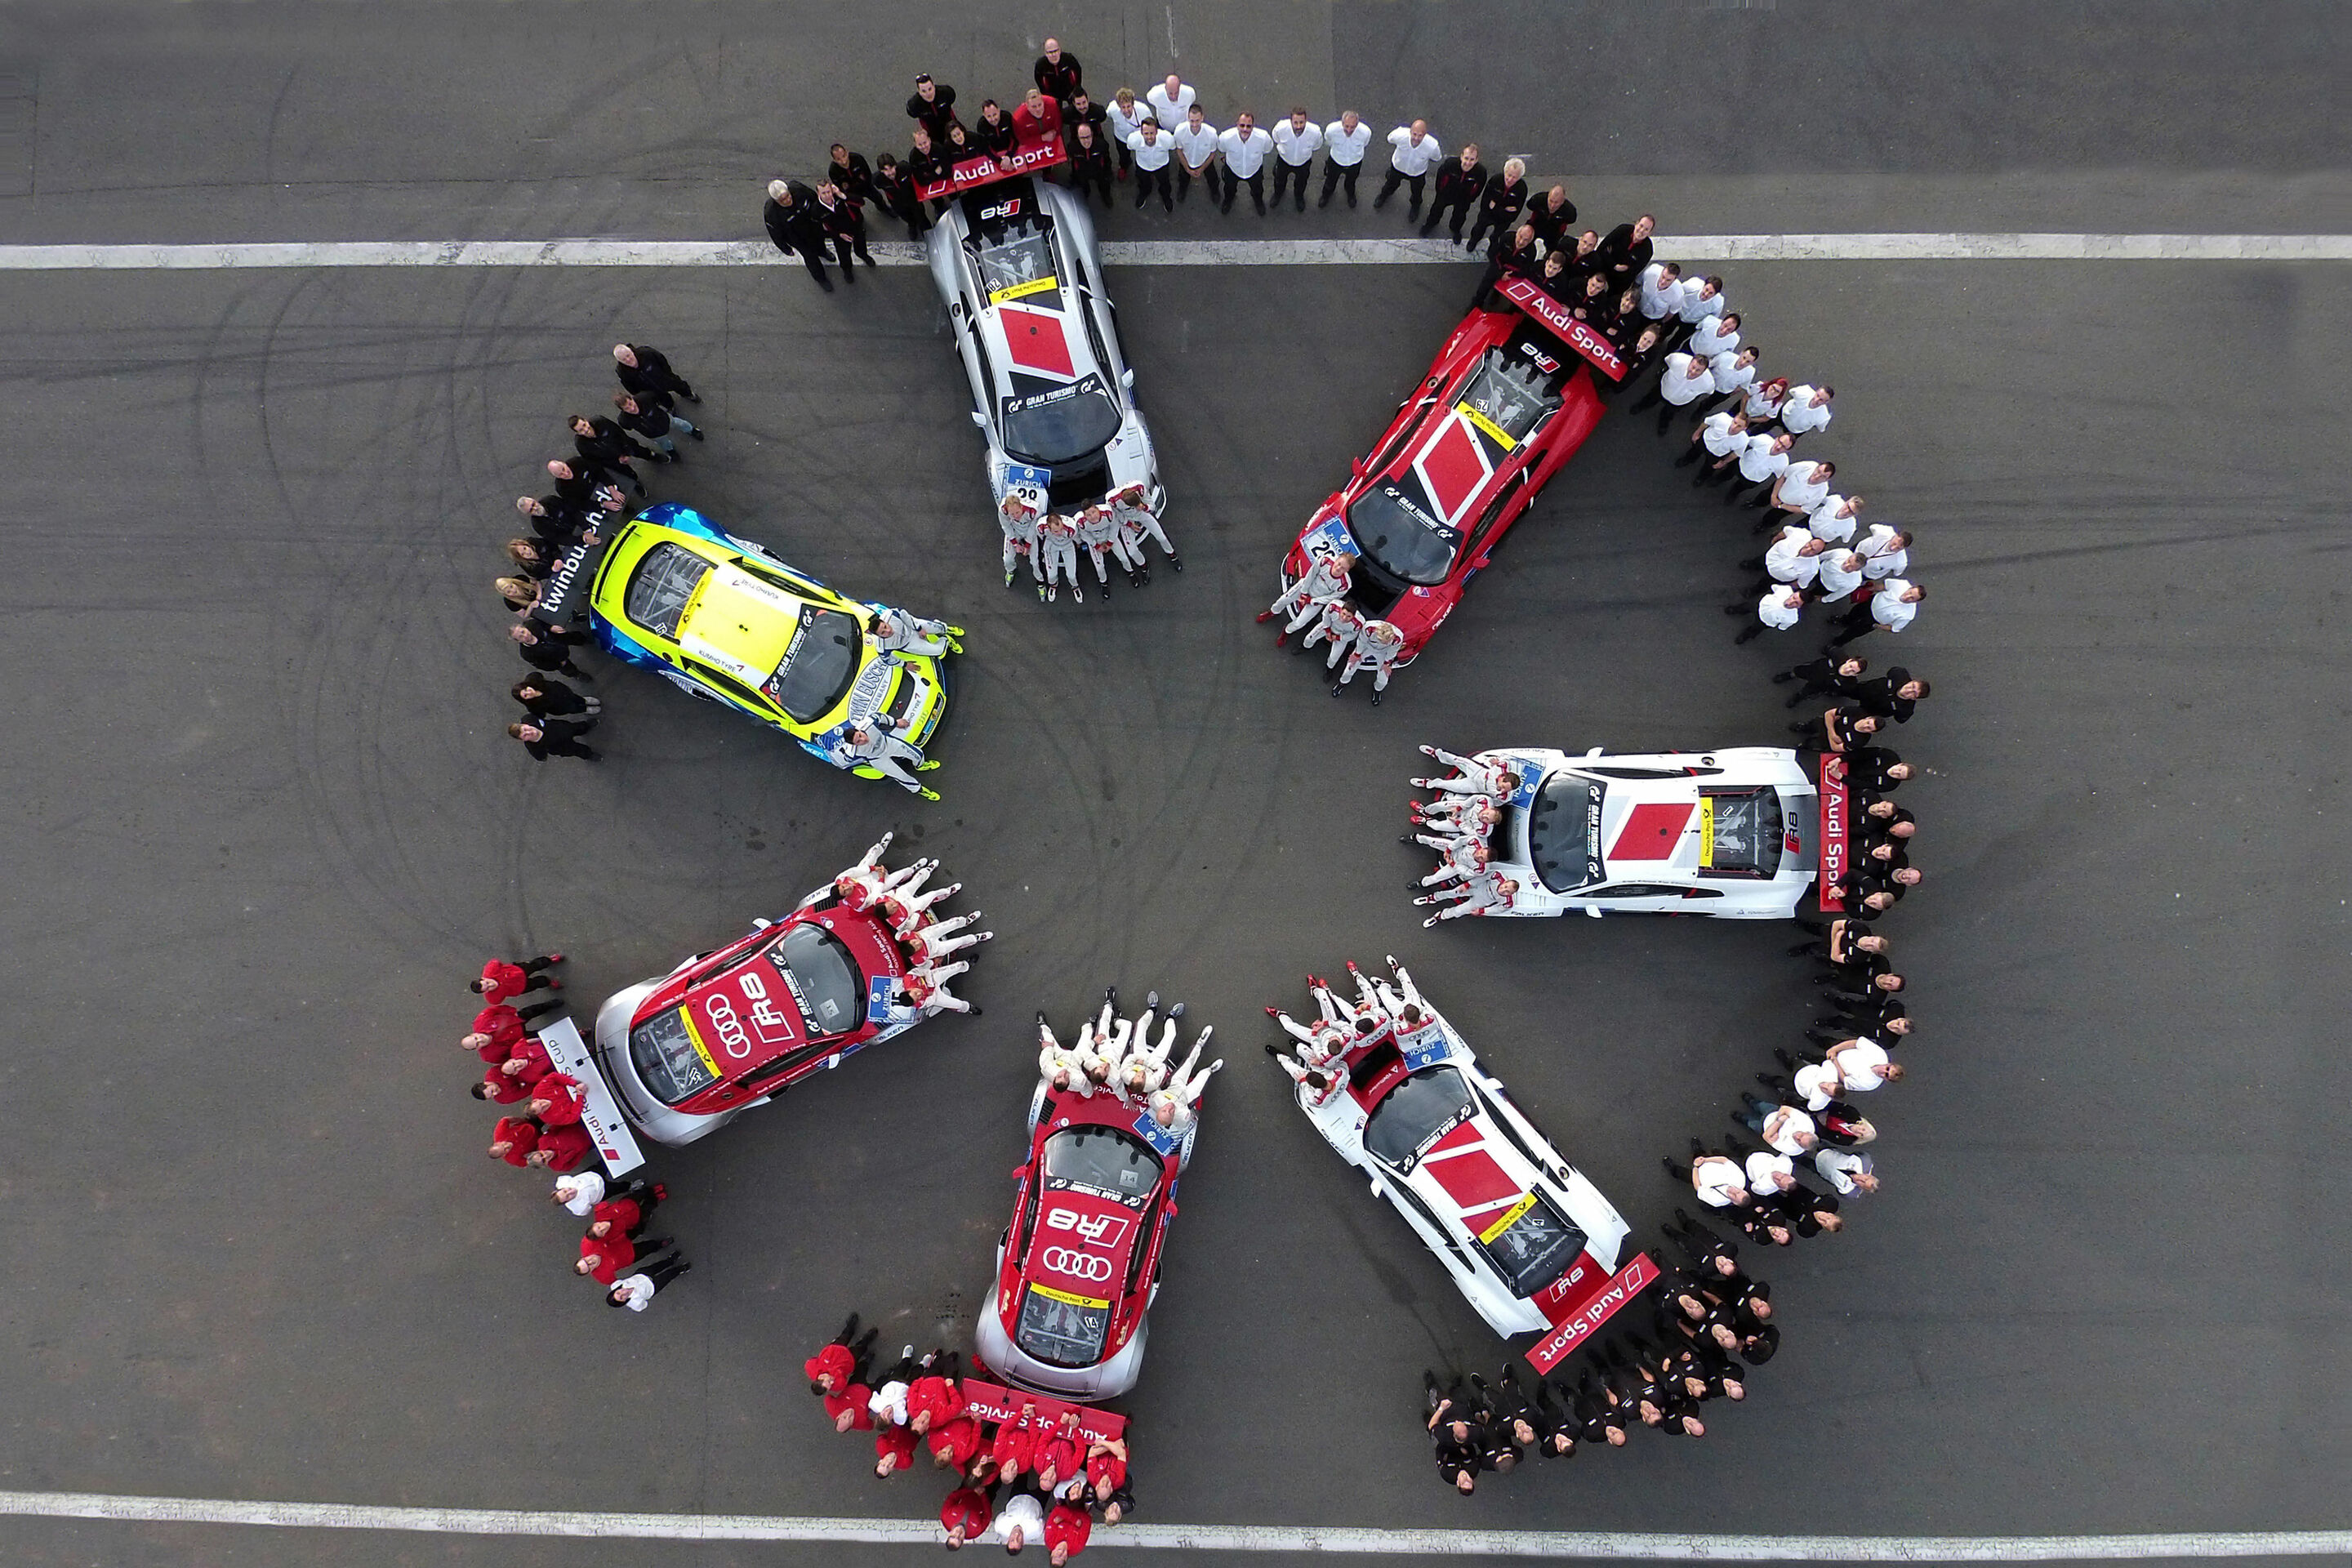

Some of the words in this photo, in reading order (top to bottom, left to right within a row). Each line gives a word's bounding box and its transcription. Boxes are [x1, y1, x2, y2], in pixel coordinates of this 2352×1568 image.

[953, 163, 996, 183] Audi
[1012, 145, 1054, 170] port
[989, 278, 1001, 292] 28
[1531, 297, 1574, 331] Audi
[1570, 325, 1620, 369] Sport
[1027, 394, 1045, 407] GRAN
[1046, 385, 1076, 402] TURISMO
[1015, 478, 1041, 488] ZURICH
[1399, 497, 1416, 513] GRAN
[1413, 507, 1439, 528] TURISMO
[1327, 532, 1343, 555] ZURIC
[698, 650, 721, 665] KUMHO
[777, 657, 792, 677] GRAN
[786, 628, 804, 659] TURISMO
[858, 660, 887, 696] BUSCH
[849, 693, 869, 721] TWIN
[871, 679, 889, 710] GERMANY
[797, 740, 824, 757] FALKEN
[1590, 804, 1598, 826] GRAN
[1828, 794, 1842, 838] Audi
[1828, 844, 1842, 899] Spor
[806, 887, 831, 902] ALKEN
[872, 933, 886, 954] Sport
[882, 952, 894, 970] Audi
[739, 972, 782, 1026] R8
[782, 969, 800, 998] TURISMO
[794, 995, 810, 1016] GRAN
[685, 1021, 699, 1045] Deutsche
[546, 1037, 567, 1065] Cup
[1410, 1042, 1436, 1057] ZURICH
[586, 1115, 610, 1147] Audi
[1147, 1118, 1169, 1140] ZURICH
[1438, 1118, 1458, 1138] GRAN
[1417, 1132, 1441, 1158] TURISMO
[1069, 1183, 1101, 1196] TURISMO
[1100, 1190, 1122, 1202] GRAN
[1046, 1208, 1107, 1238] R8
[1557, 1267, 1584, 1295] R8
[1045, 1290, 1069, 1301] Deutsche
[1586, 1286, 1624, 1325] Audi
[1085, 1316, 1098, 1328] 14
[1540, 1320, 1588, 1361] Sport
